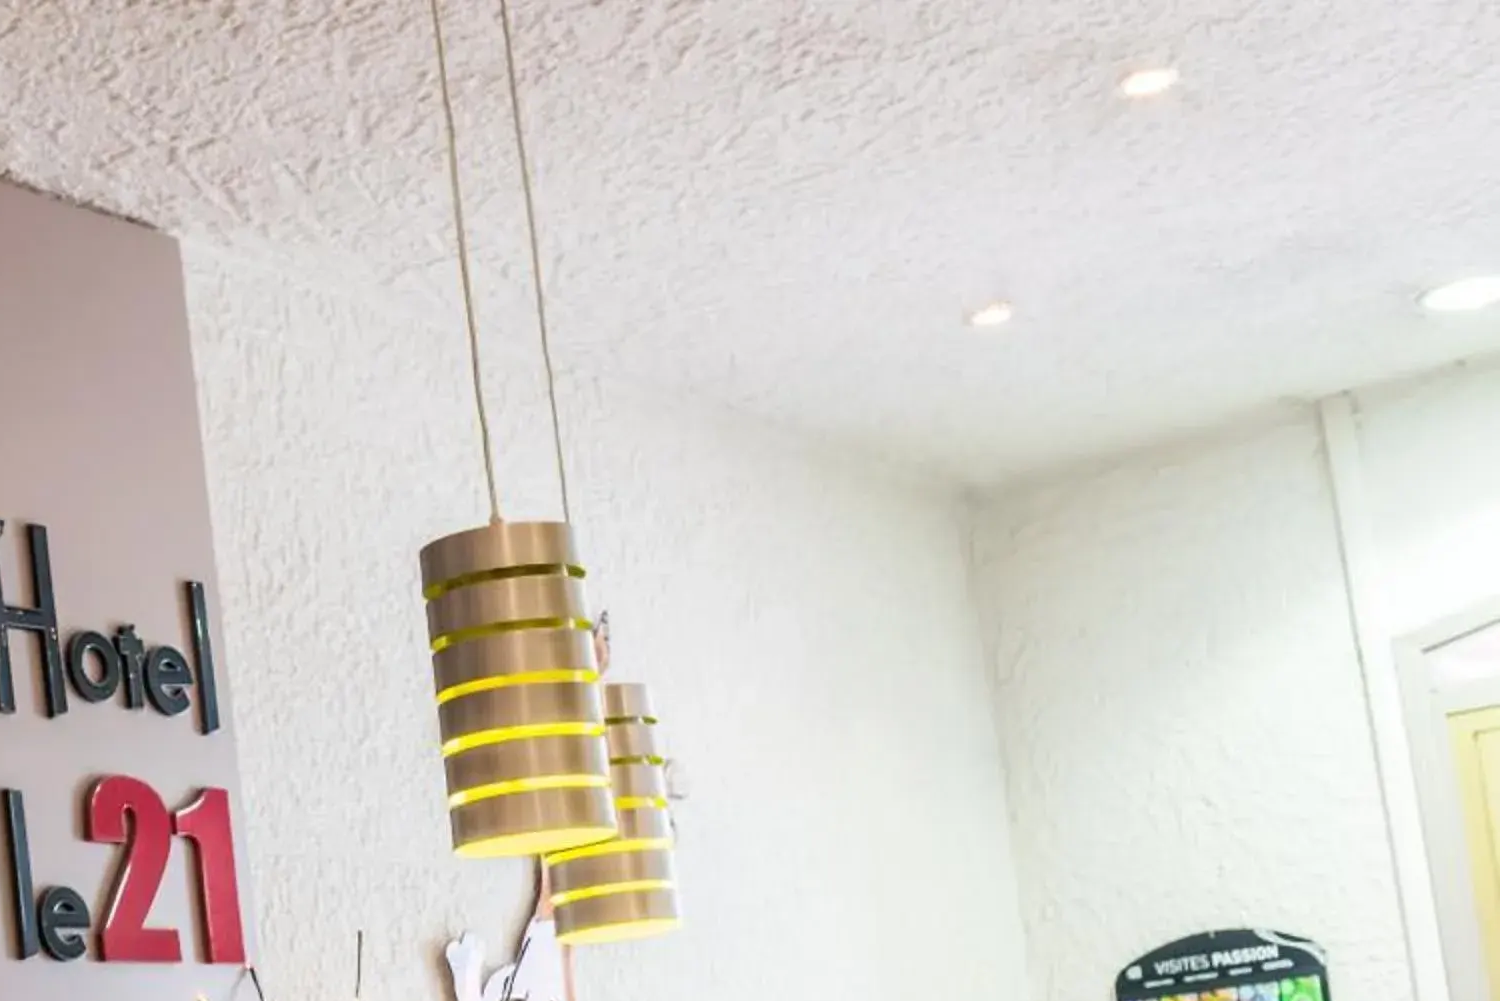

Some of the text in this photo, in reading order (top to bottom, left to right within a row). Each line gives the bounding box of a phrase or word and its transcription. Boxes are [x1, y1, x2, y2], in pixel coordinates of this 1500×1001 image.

[83, 773, 247, 964] 21
[1153, 944, 1280, 977] VISITES PASSION
